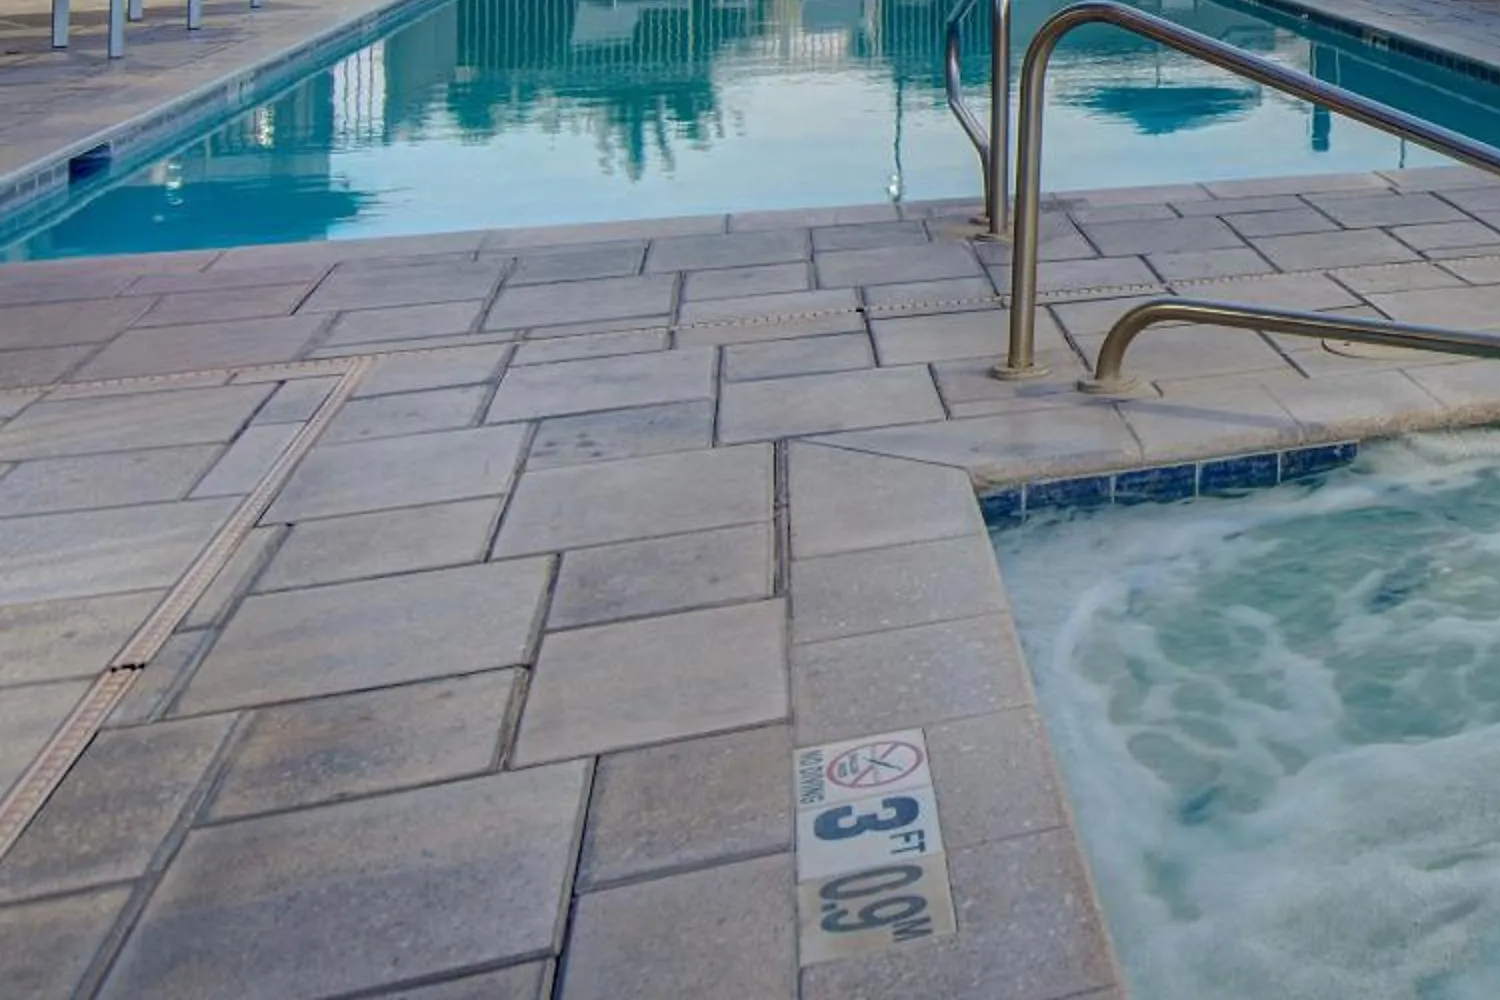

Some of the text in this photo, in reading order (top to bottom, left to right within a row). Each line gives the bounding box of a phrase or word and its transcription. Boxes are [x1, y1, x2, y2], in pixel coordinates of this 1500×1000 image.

[814, 796, 926, 855] 3 FT
[819, 864, 928, 933] 0.9
